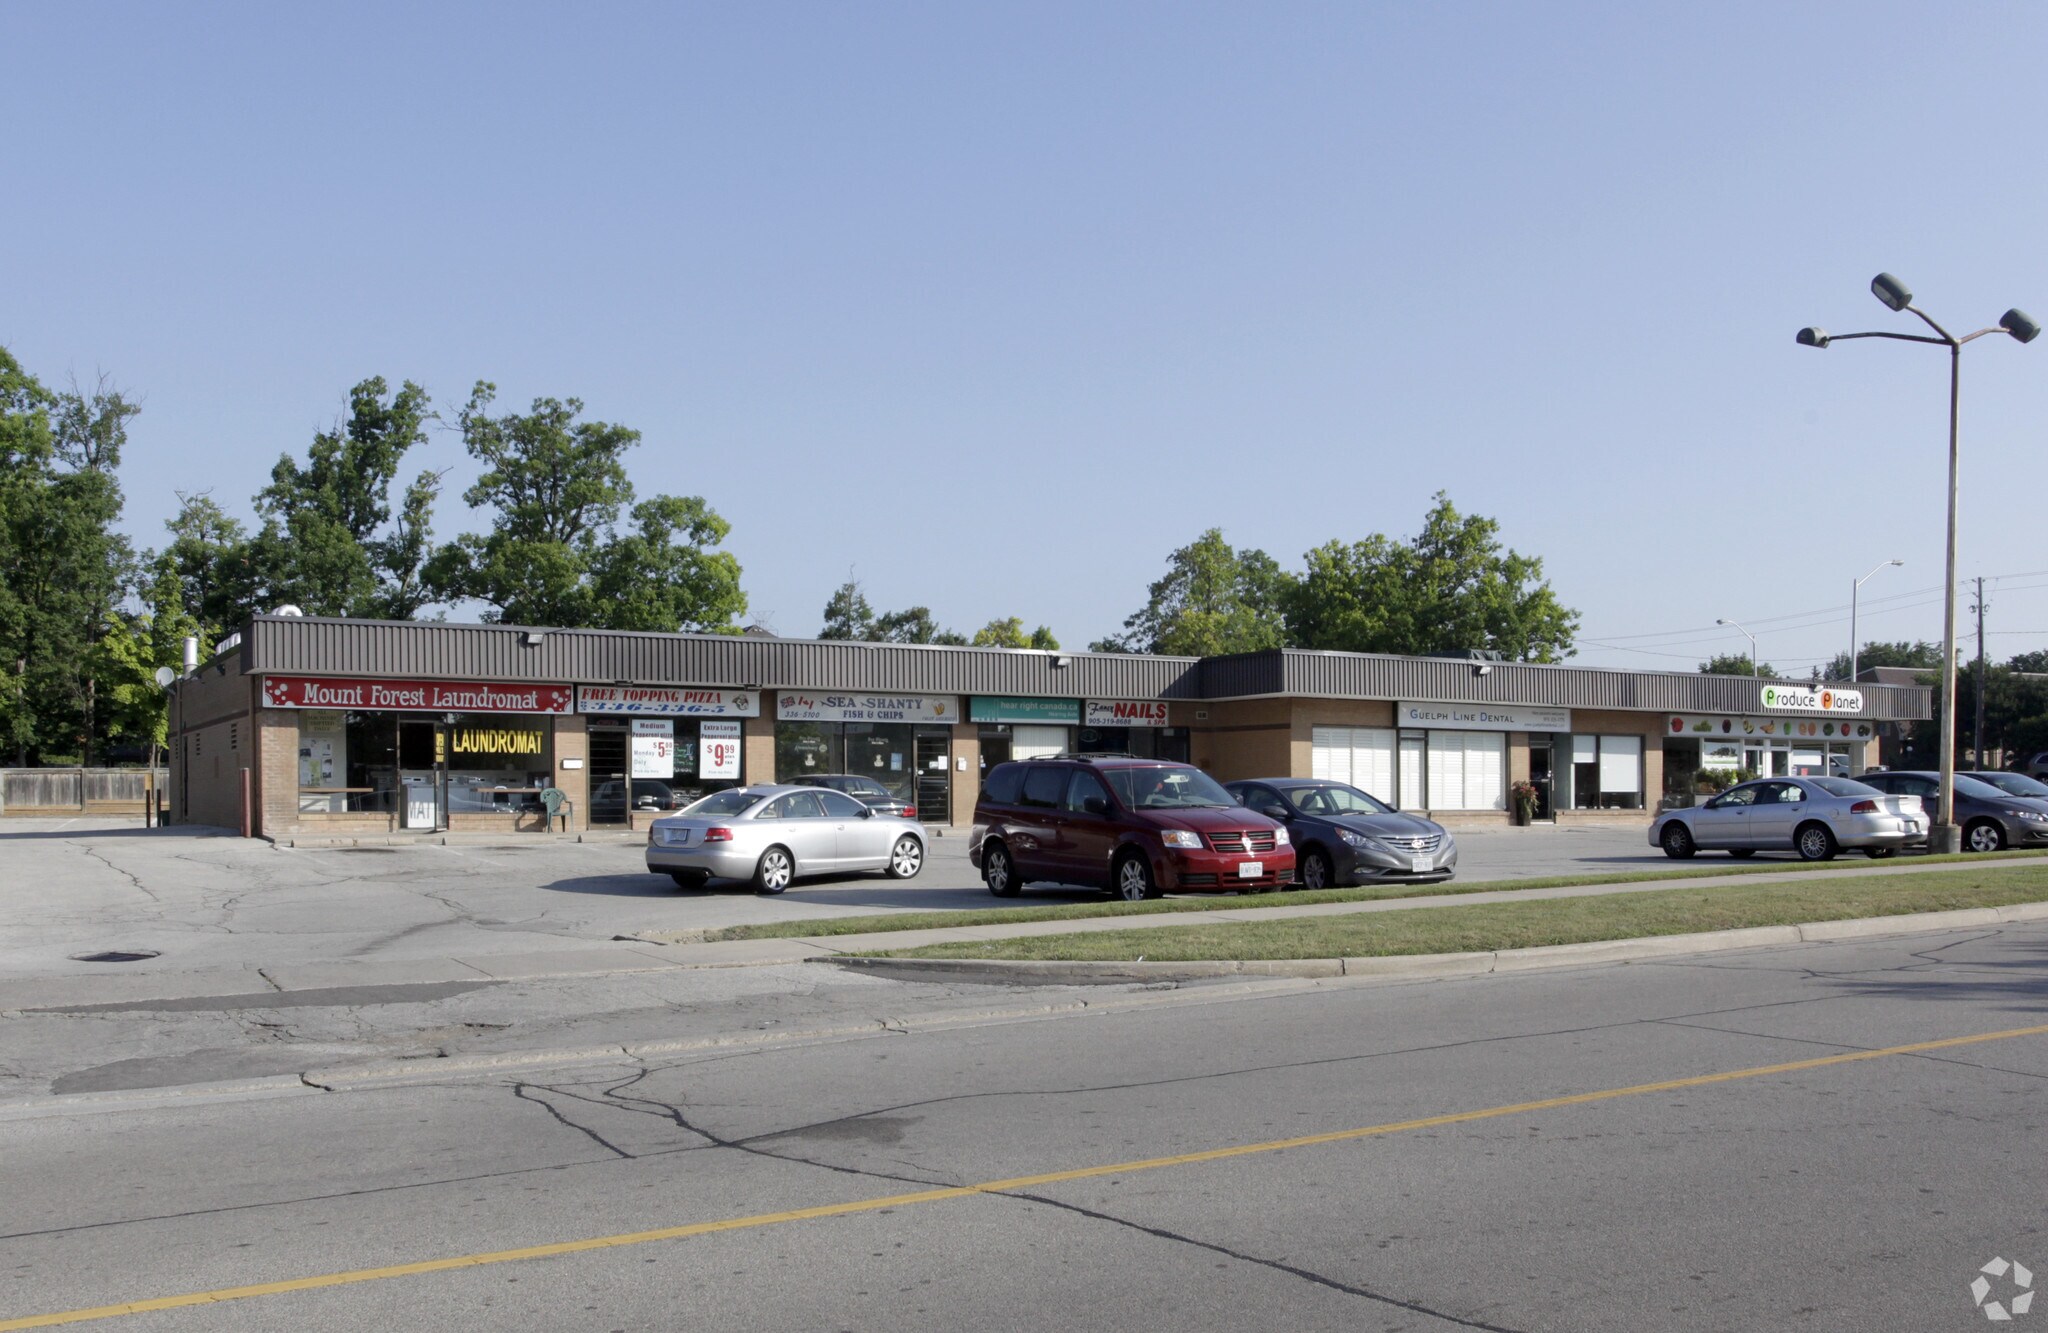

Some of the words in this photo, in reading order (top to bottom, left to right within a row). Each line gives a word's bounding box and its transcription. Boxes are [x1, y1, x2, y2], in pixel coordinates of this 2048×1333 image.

[303, 683, 363, 704] Mount
[370, 686, 426, 706] Forest
[432, 686, 538, 708] Laundromat
[582, 688, 618, 700] FREE
[622, 690, 682, 702] TOPPING
[684, 692, 722, 704] PIZZA
[822, 696, 856, 708] SEA
[862, 697, 923, 710] SHANTY
[1766, 690, 1815, 707] Produce
[1824, 693, 1859, 709] Planet
[843, 710, 863, 718] FISH
[867, 711, 874, 719] &
[877, 711, 903, 719] CHIPS
[1020, 703, 1038, 711] right
[1114, 702, 1166, 718] NAILS
[1410, 709, 1448, 720] GUELPH
[1453, 711, 1476, 721] LINE
[1480, 712, 1514, 723] DENTAL
[453, 729, 544, 754] LAUNDROMAT
